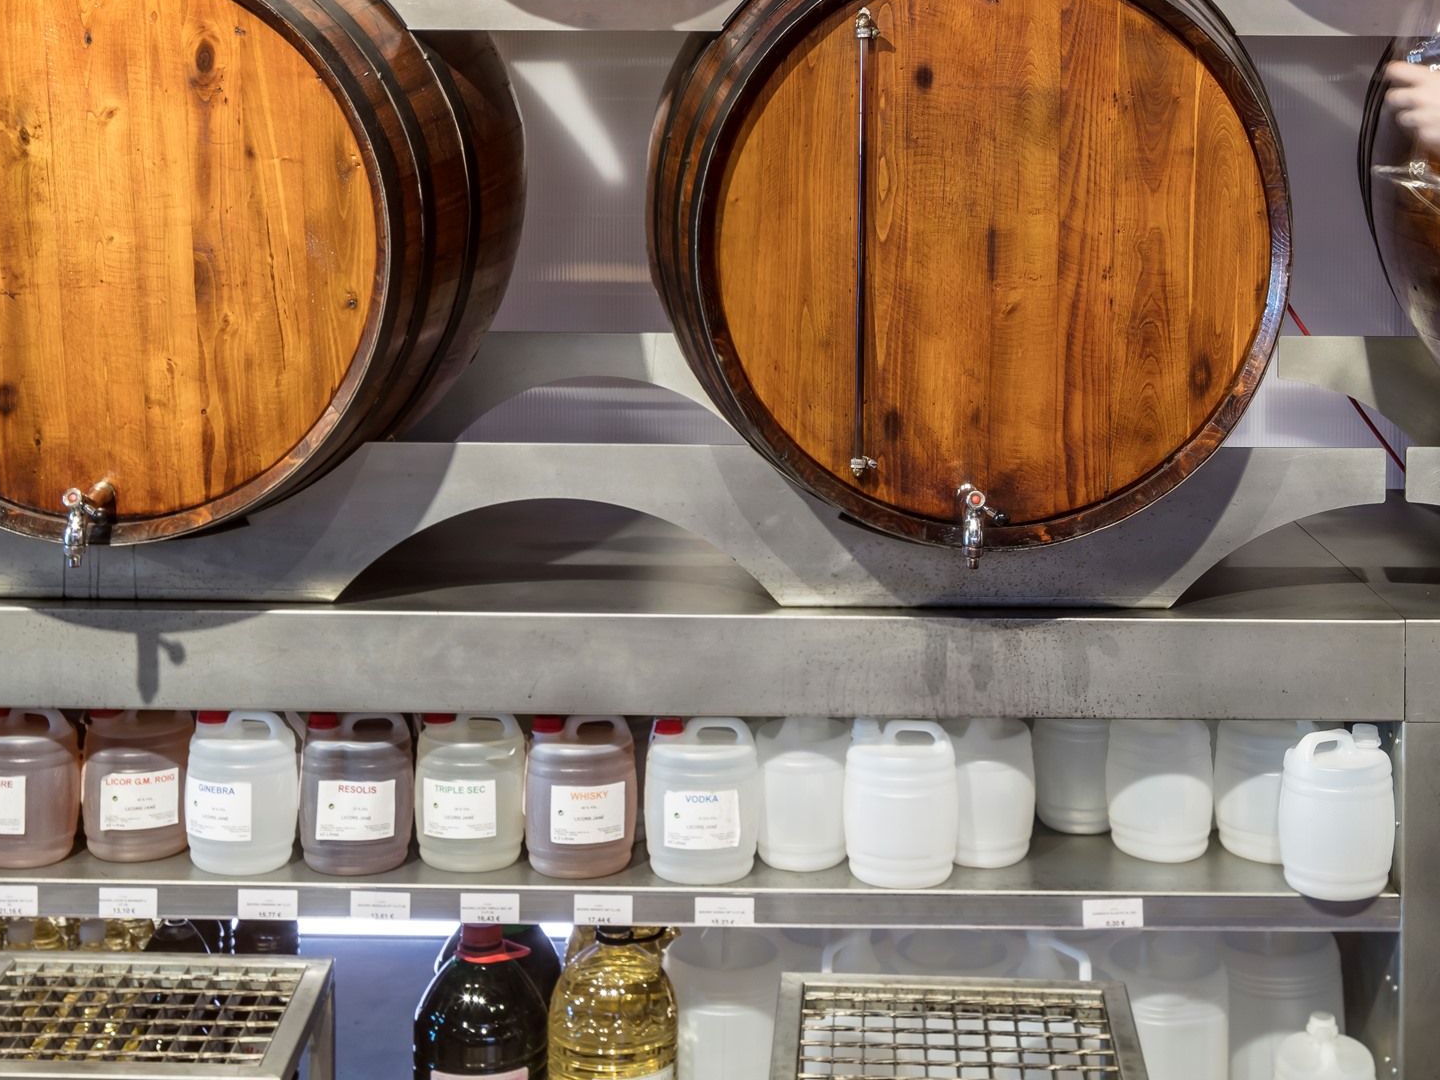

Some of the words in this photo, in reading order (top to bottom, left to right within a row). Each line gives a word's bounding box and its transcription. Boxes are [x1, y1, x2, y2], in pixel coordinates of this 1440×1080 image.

[105, 777, 132, 786] LICOR
[134, 777, 152, 785] G.M.
[154, 773, 175, 783] ROIG
[198, 783, 235, 795] GINEBRA
[338, 785, 377, 794] RESOLIS
[434, 784, 465, 794] TRIPLE
[466, 785, 486, 794] SEC
[570, 791, 609, 800] WHISKY
[685, 795, 719, 803] VODKA
